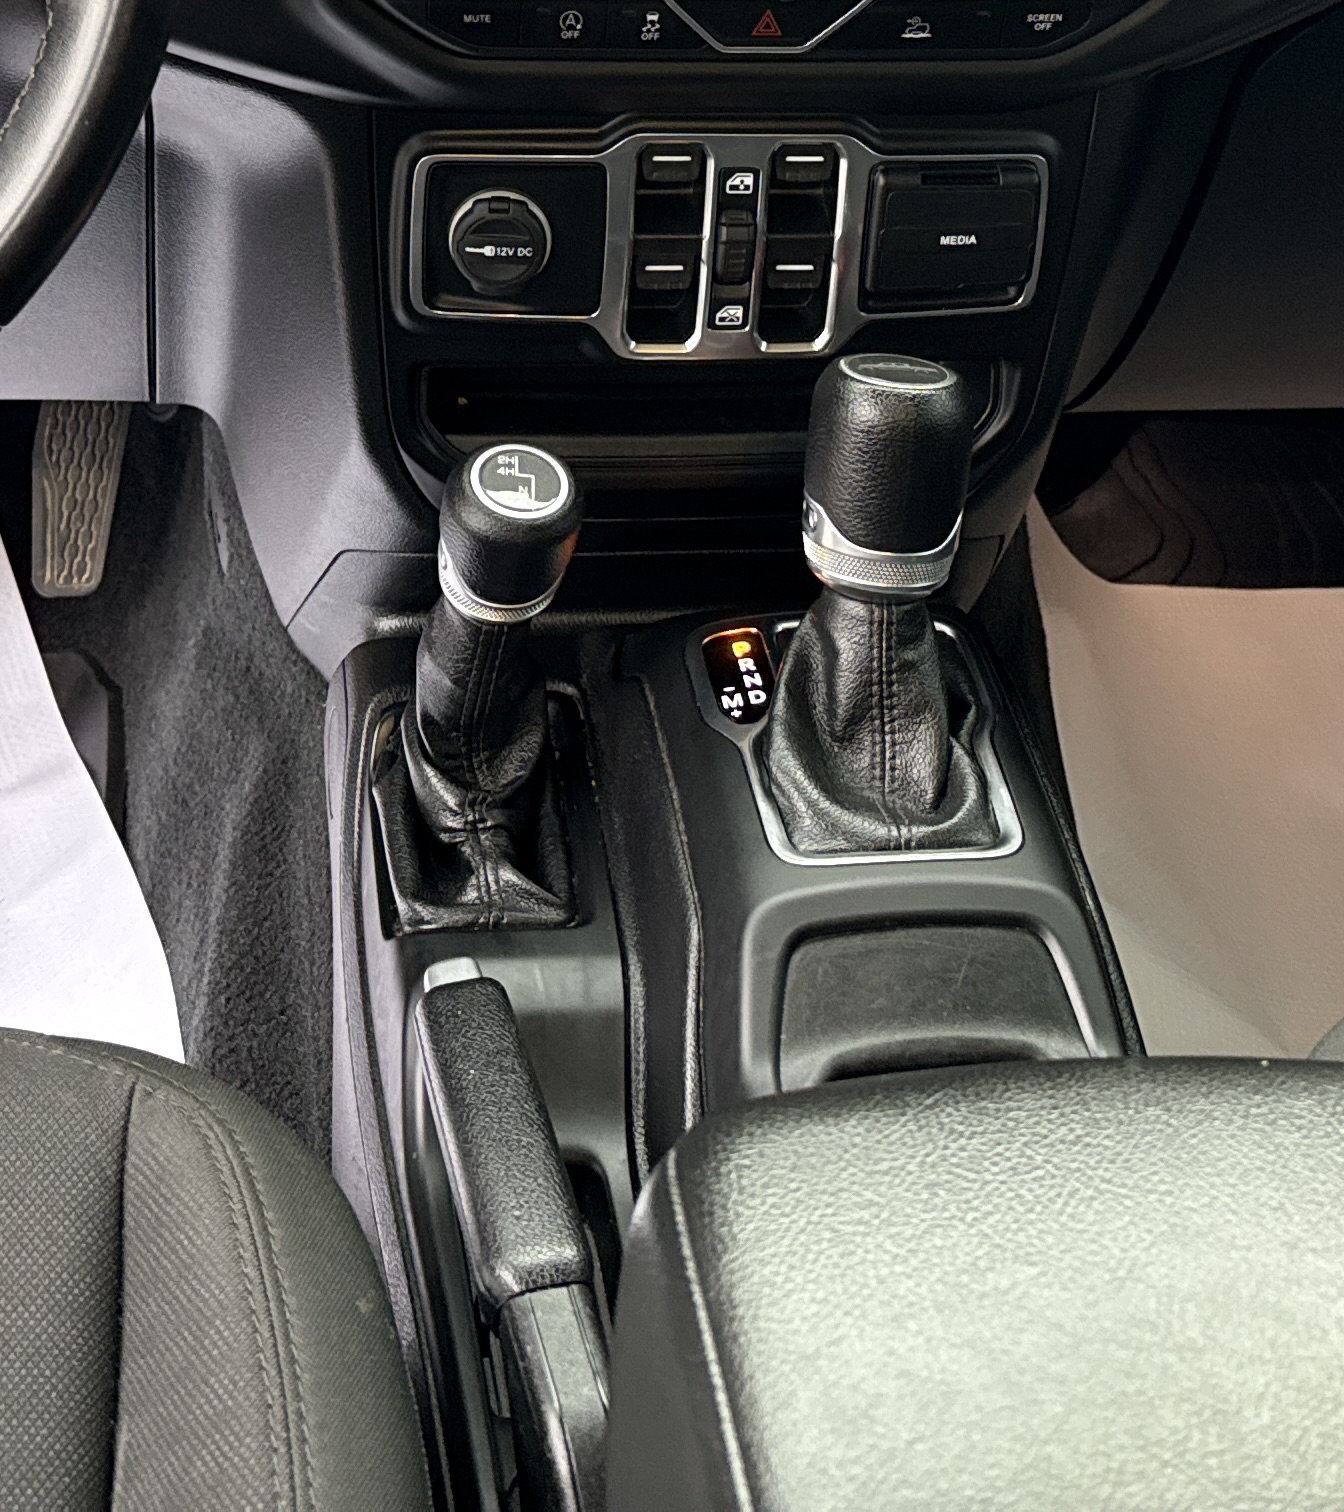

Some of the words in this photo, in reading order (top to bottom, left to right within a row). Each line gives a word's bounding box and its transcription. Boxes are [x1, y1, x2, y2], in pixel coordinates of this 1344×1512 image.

[463, 14, 491, 24] MUTE
[1026, 13, 1063, 23] SCREEN
[1034, 23, 1052, 32] OFF
[560, 31, 580, 39] OFF
[641, 32, 660, 41] OFF
[940, 234, 977, 246] MEDIA
[497, 247, 514, 257] 12V
[517, 247, 533, 257] DC
[497, 455, 515, 465] 2H
[496, 466, 515, 476] 4H
[518, 485, 529, 495] N
[732, 640, 751, 658] P
[738, 657, 757, 672] R
[743, 673, 763, 688] N
[721, 693, 744, 709] M
[748, 690, 767, 705] D
